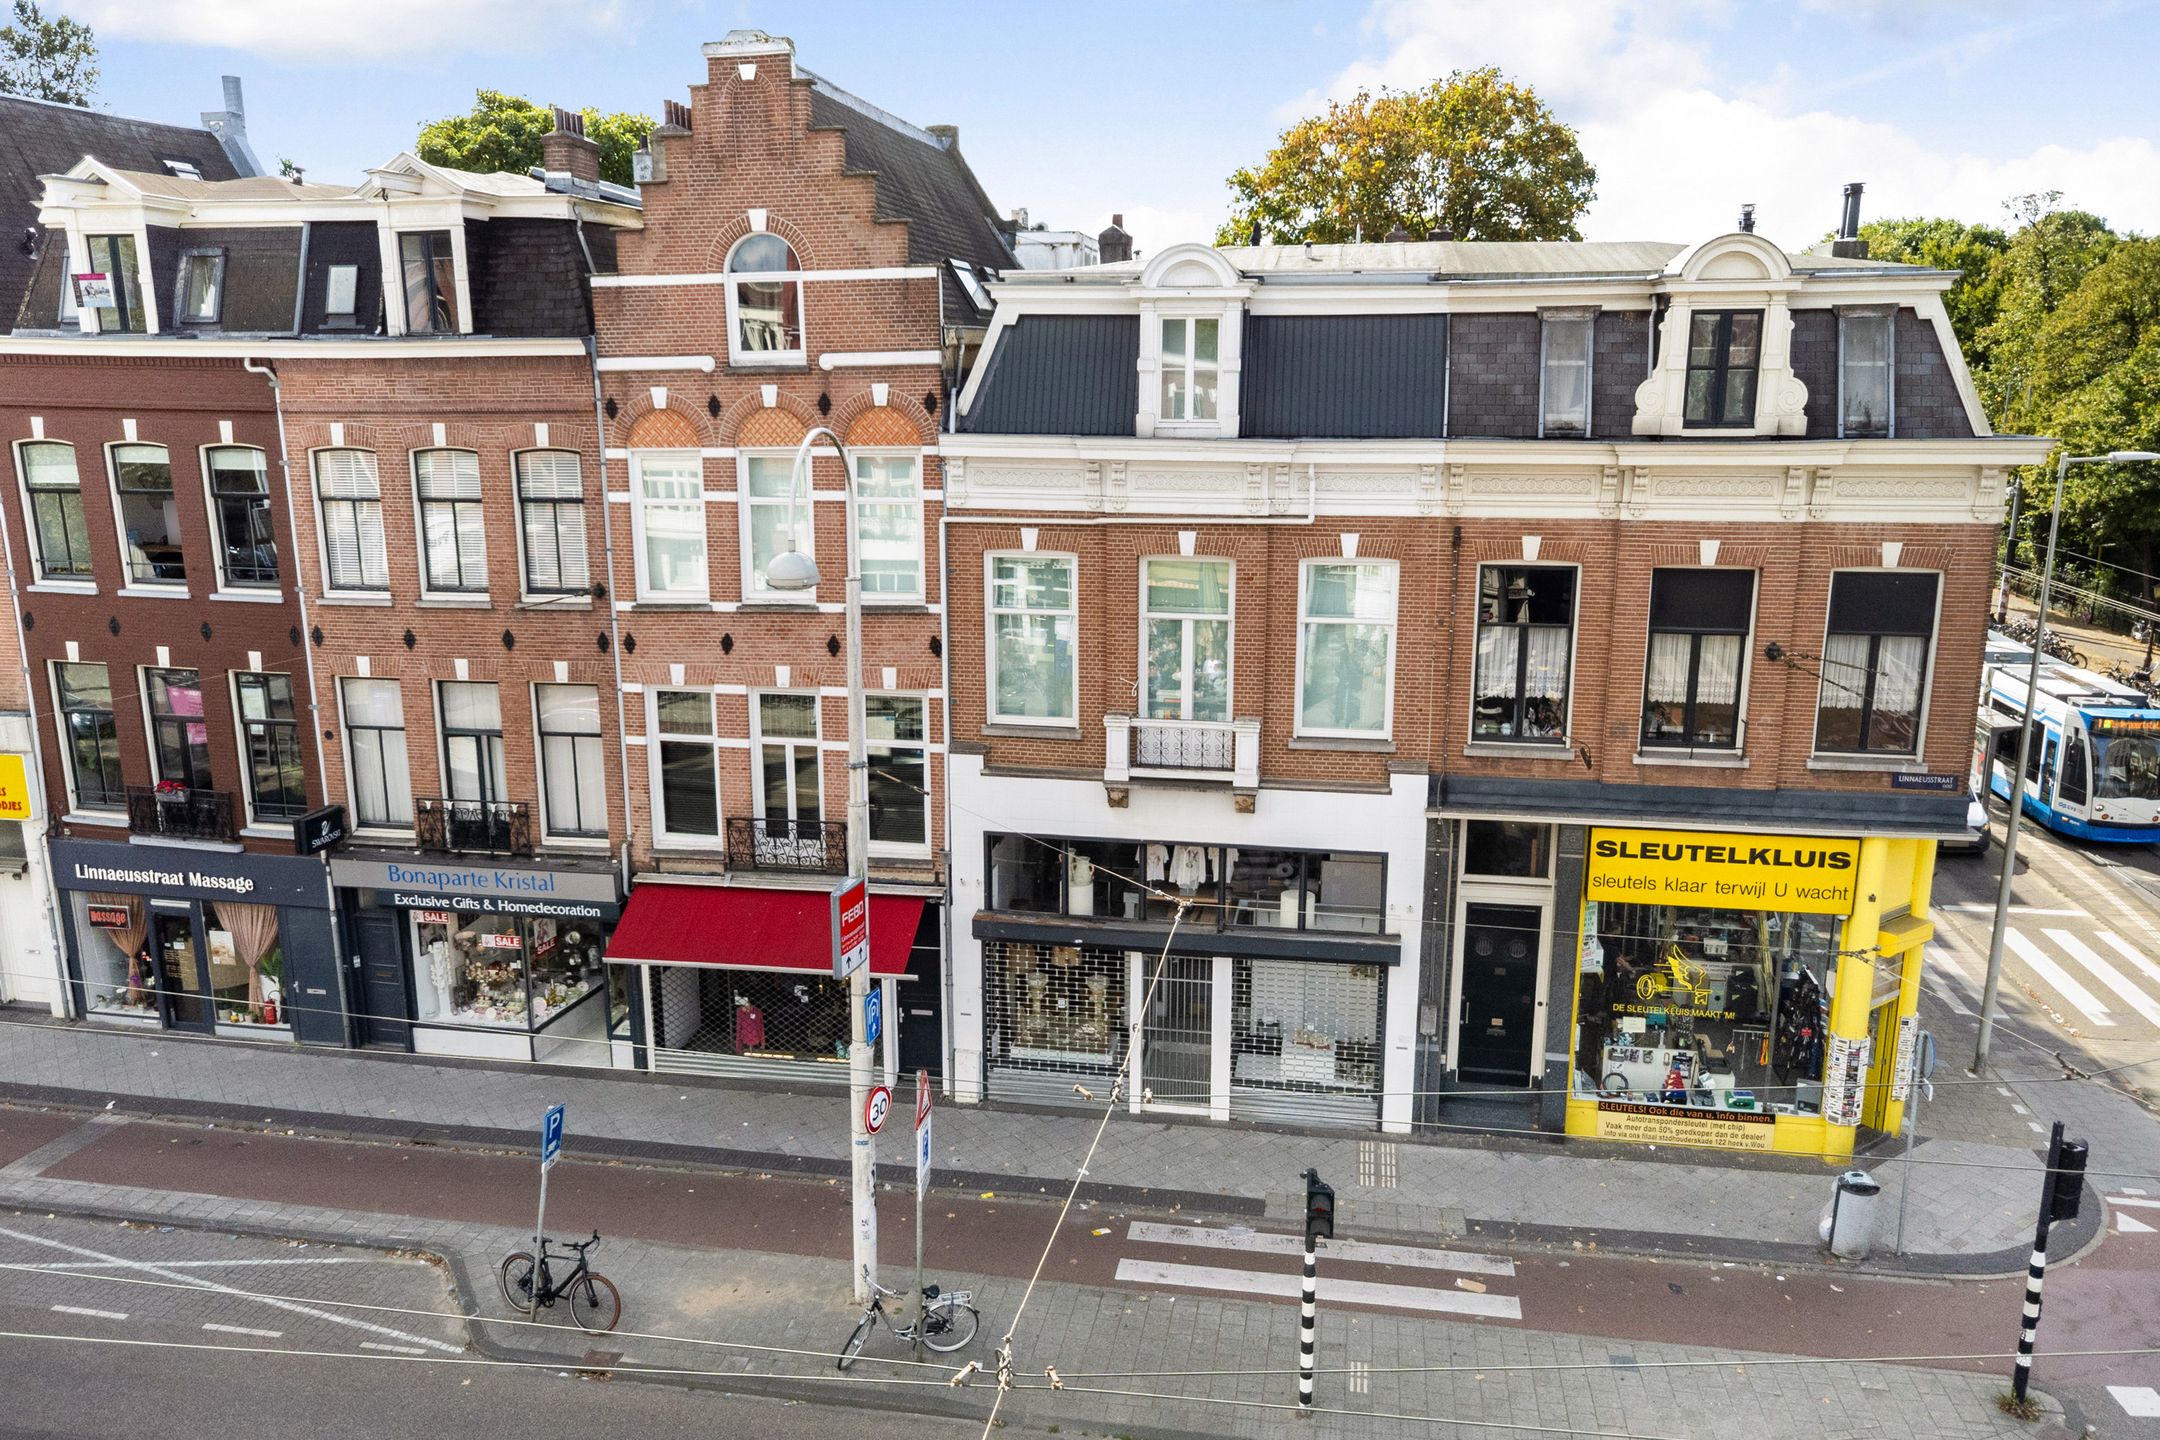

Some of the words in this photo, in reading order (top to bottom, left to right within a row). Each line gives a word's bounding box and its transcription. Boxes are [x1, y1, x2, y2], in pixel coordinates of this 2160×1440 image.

[1898, 775, 1954, 784] LINNAEUSSTRAAT
[1595, 840, 1852, 870] SLEUTELKLUIS
[75, 863, 184, 886] Linnaeusstraat
[189, 872, 254, 893] Massage
[387, 864, 489, 890] Bonaparte
[494, 871, 555, 892] Kristal
[1592, 874, 1657, 890] sleutels
[1664, 876, 1708, 893] klaar
[1715, 879, 1766, 899] terwijl
[1774, 882, 1788, 897] U
[1796, 886, 1849, 901] wacht
[394, 893, 450, 908] Exclusive
[452, 897, 480, 910] Gifts
[483, 899, 495, 911] &
[498, 900, 600, 917] Homedecoration
[842, 900, 864, 927] FEBO
[90, 910, 126, 926] massage
[423, 911, 449, 923] SALE
[495, 936, 520, 948] SALE
[537, 936, 555, 955] SALE
[1613, 1003, 1625, 1012] DE
[1627, 1005, 1691, 1015] SLEUTELKLUIS
[1692, 1009, 1721, 1018] MAAKT
[872, 1098, 887, 1121] 30
[1600, 1102, 1647, 1114] SLEUTELS!
[1648, 1106, 1668, 1115] Ook
[1669, 1109, 1685, 1117] die
[1686, 1111, 1703, 1119] van
[1737, 1113, 1773, 1123] binnen.
[549, 1112, 560, 1139] P
[1605, 1122, 1623, 1130] Vaak
[1643, 1125, 1657, 1133] dan
[1658, 1126, 1674, 1134] 50%
[1675, 1127, 1713, 1138] goedkoper
[1741, 1133, 1766, 1141] dealer!
[1626, 1114, 1708, 1129] Autotranspondersleutel
[1710, 1122, 1726, 1131] (met
[1728, 1123, 1746, 1131] chip)
[1715, 1138, 1727, 1146] 122
[1728, 1139, 1743, 1147] hoek
